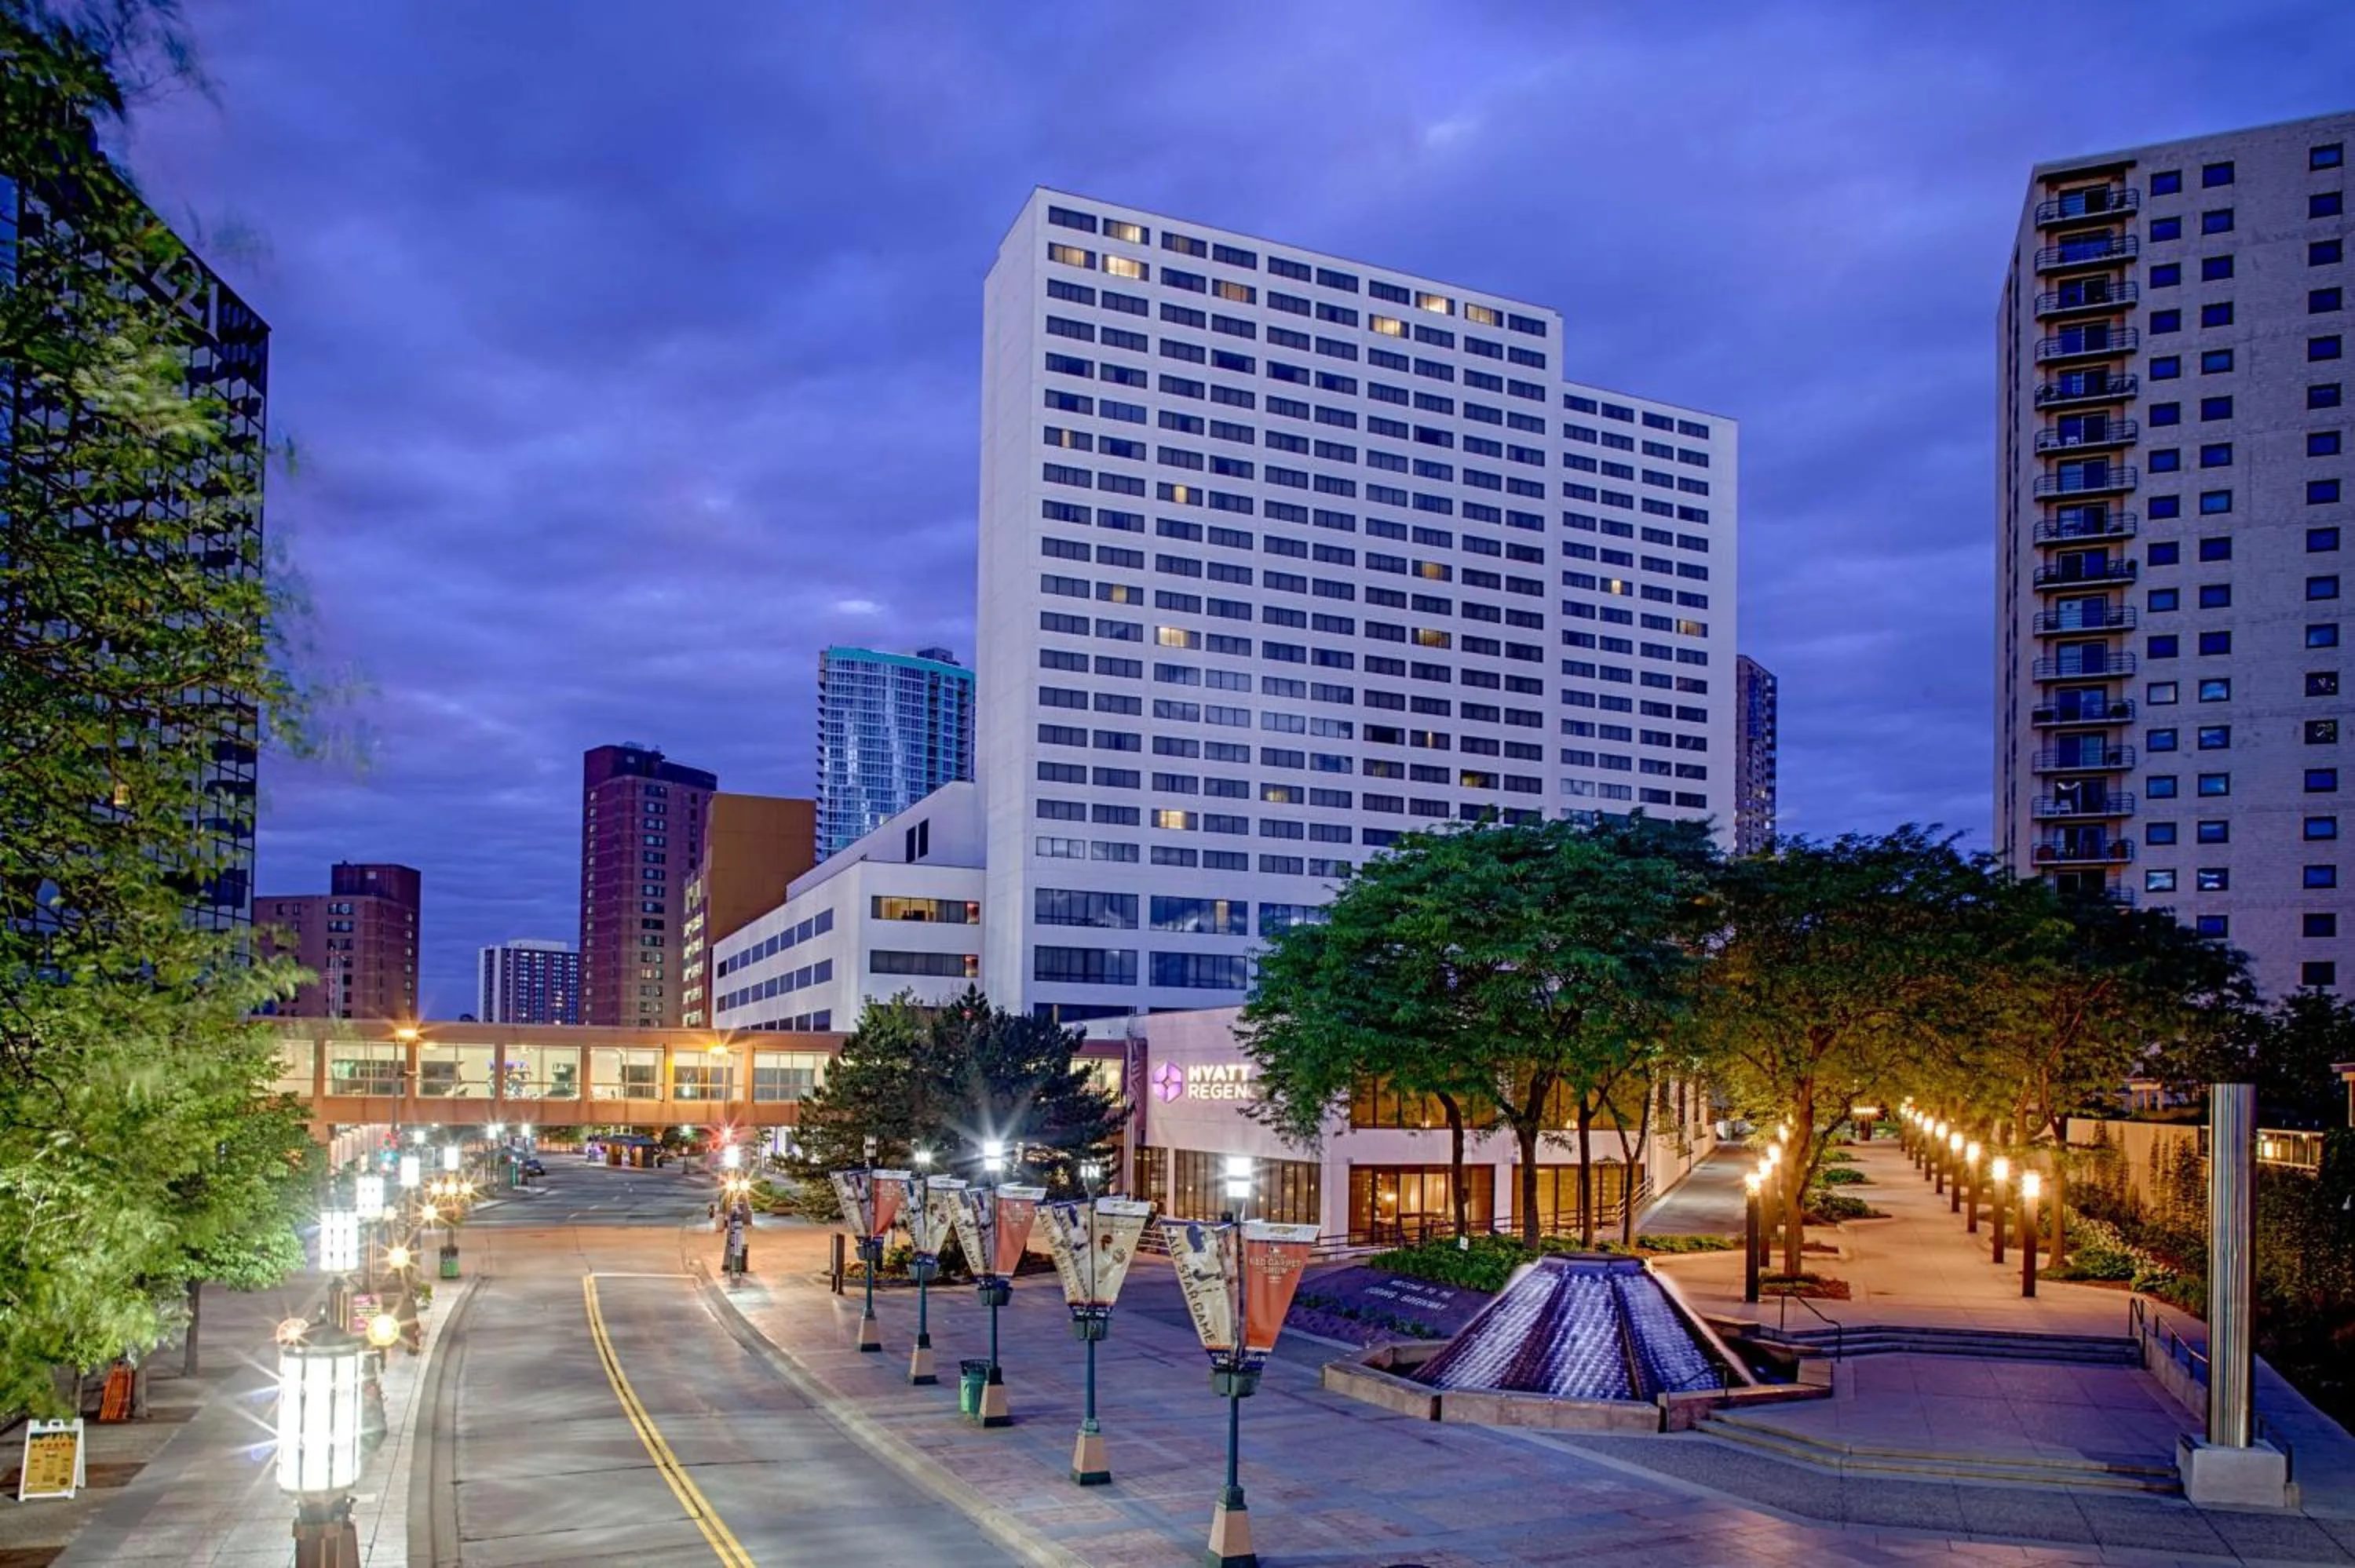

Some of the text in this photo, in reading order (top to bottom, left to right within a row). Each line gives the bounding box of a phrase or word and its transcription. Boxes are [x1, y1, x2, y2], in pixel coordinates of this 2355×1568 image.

[1188, 1065, 1251, 1082] HYATT
[1188, 1083, 1260, 1099] REGENC
[1263, 1266, 1288, 1275] SHOW
[1167, 1235, 1216, 1343] ALL STAR GAME
